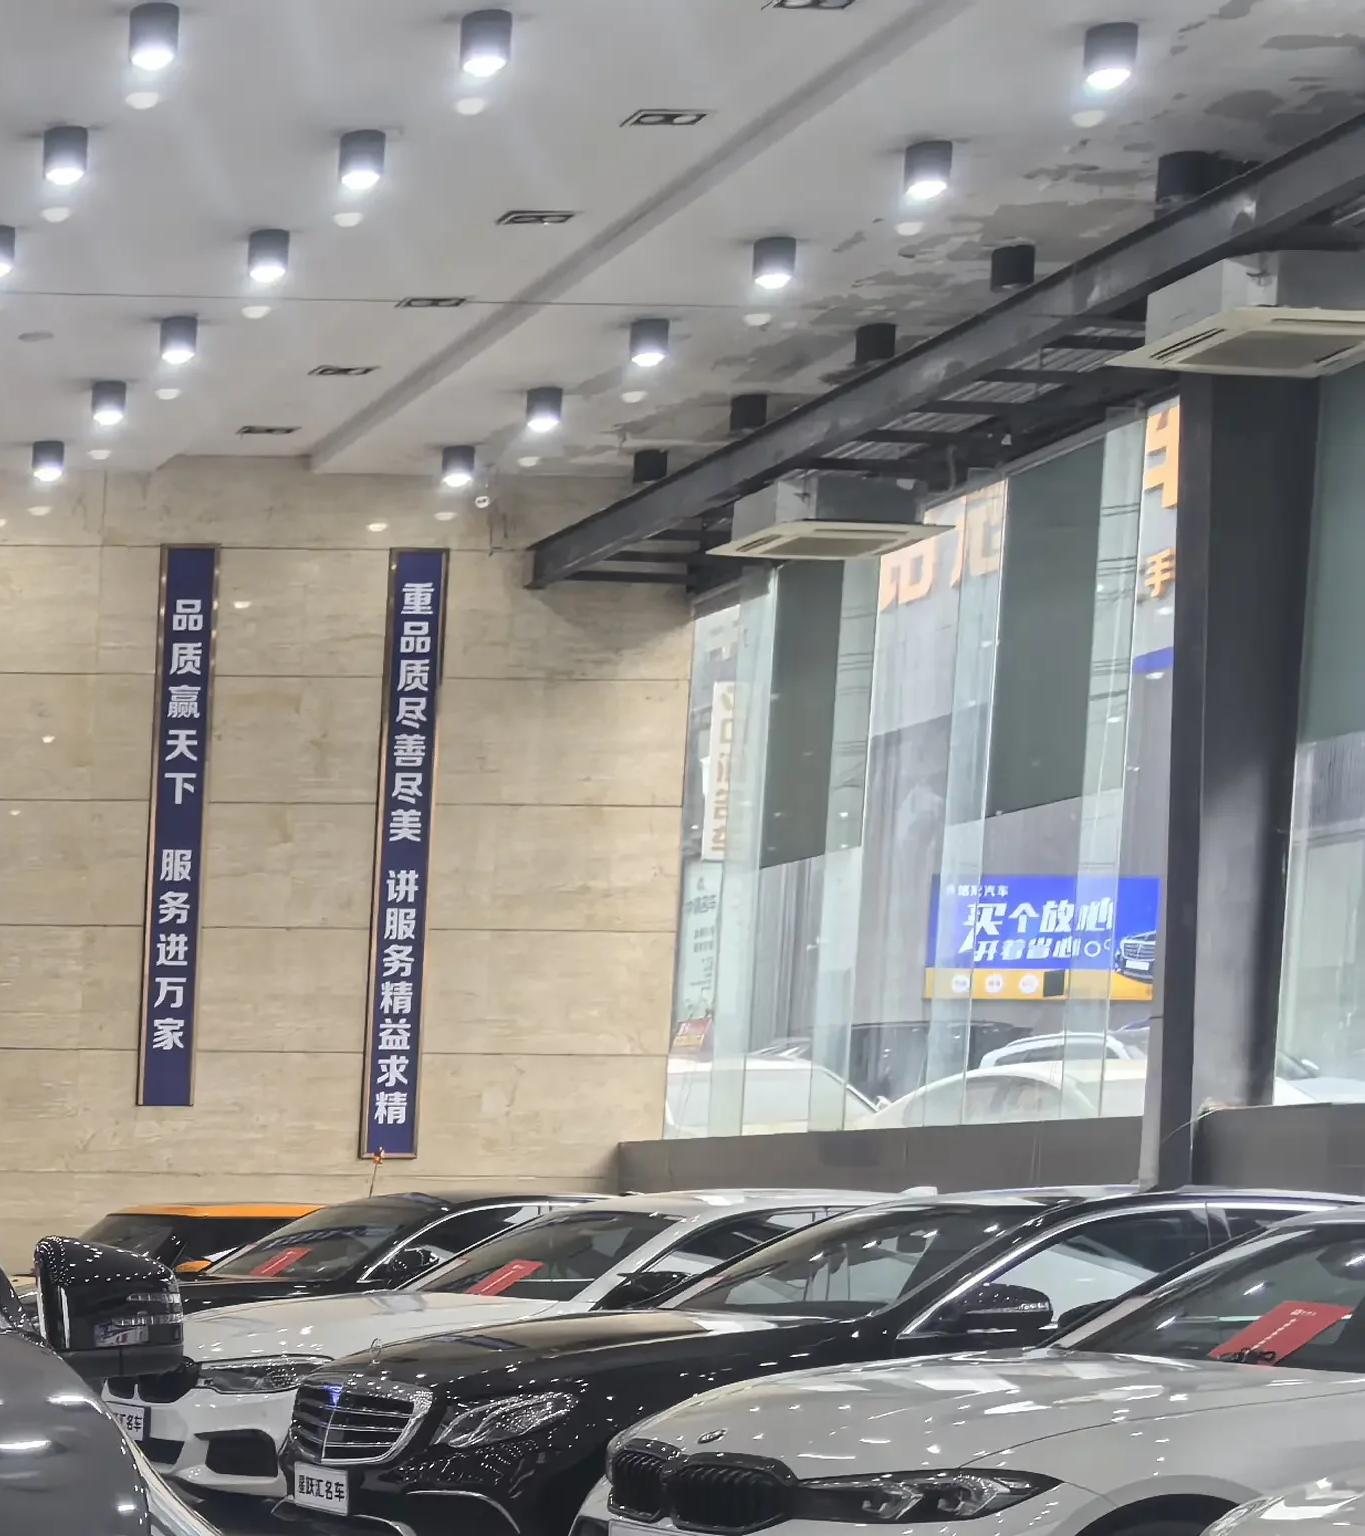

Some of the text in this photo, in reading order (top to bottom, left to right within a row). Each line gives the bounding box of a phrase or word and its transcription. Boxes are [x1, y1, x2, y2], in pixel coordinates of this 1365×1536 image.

[152, 599, 204, 1051] 品质赢天下 服务进万家
[374, 582, 434, 1126] 重品质尽善尽美 讲服务精益求精
